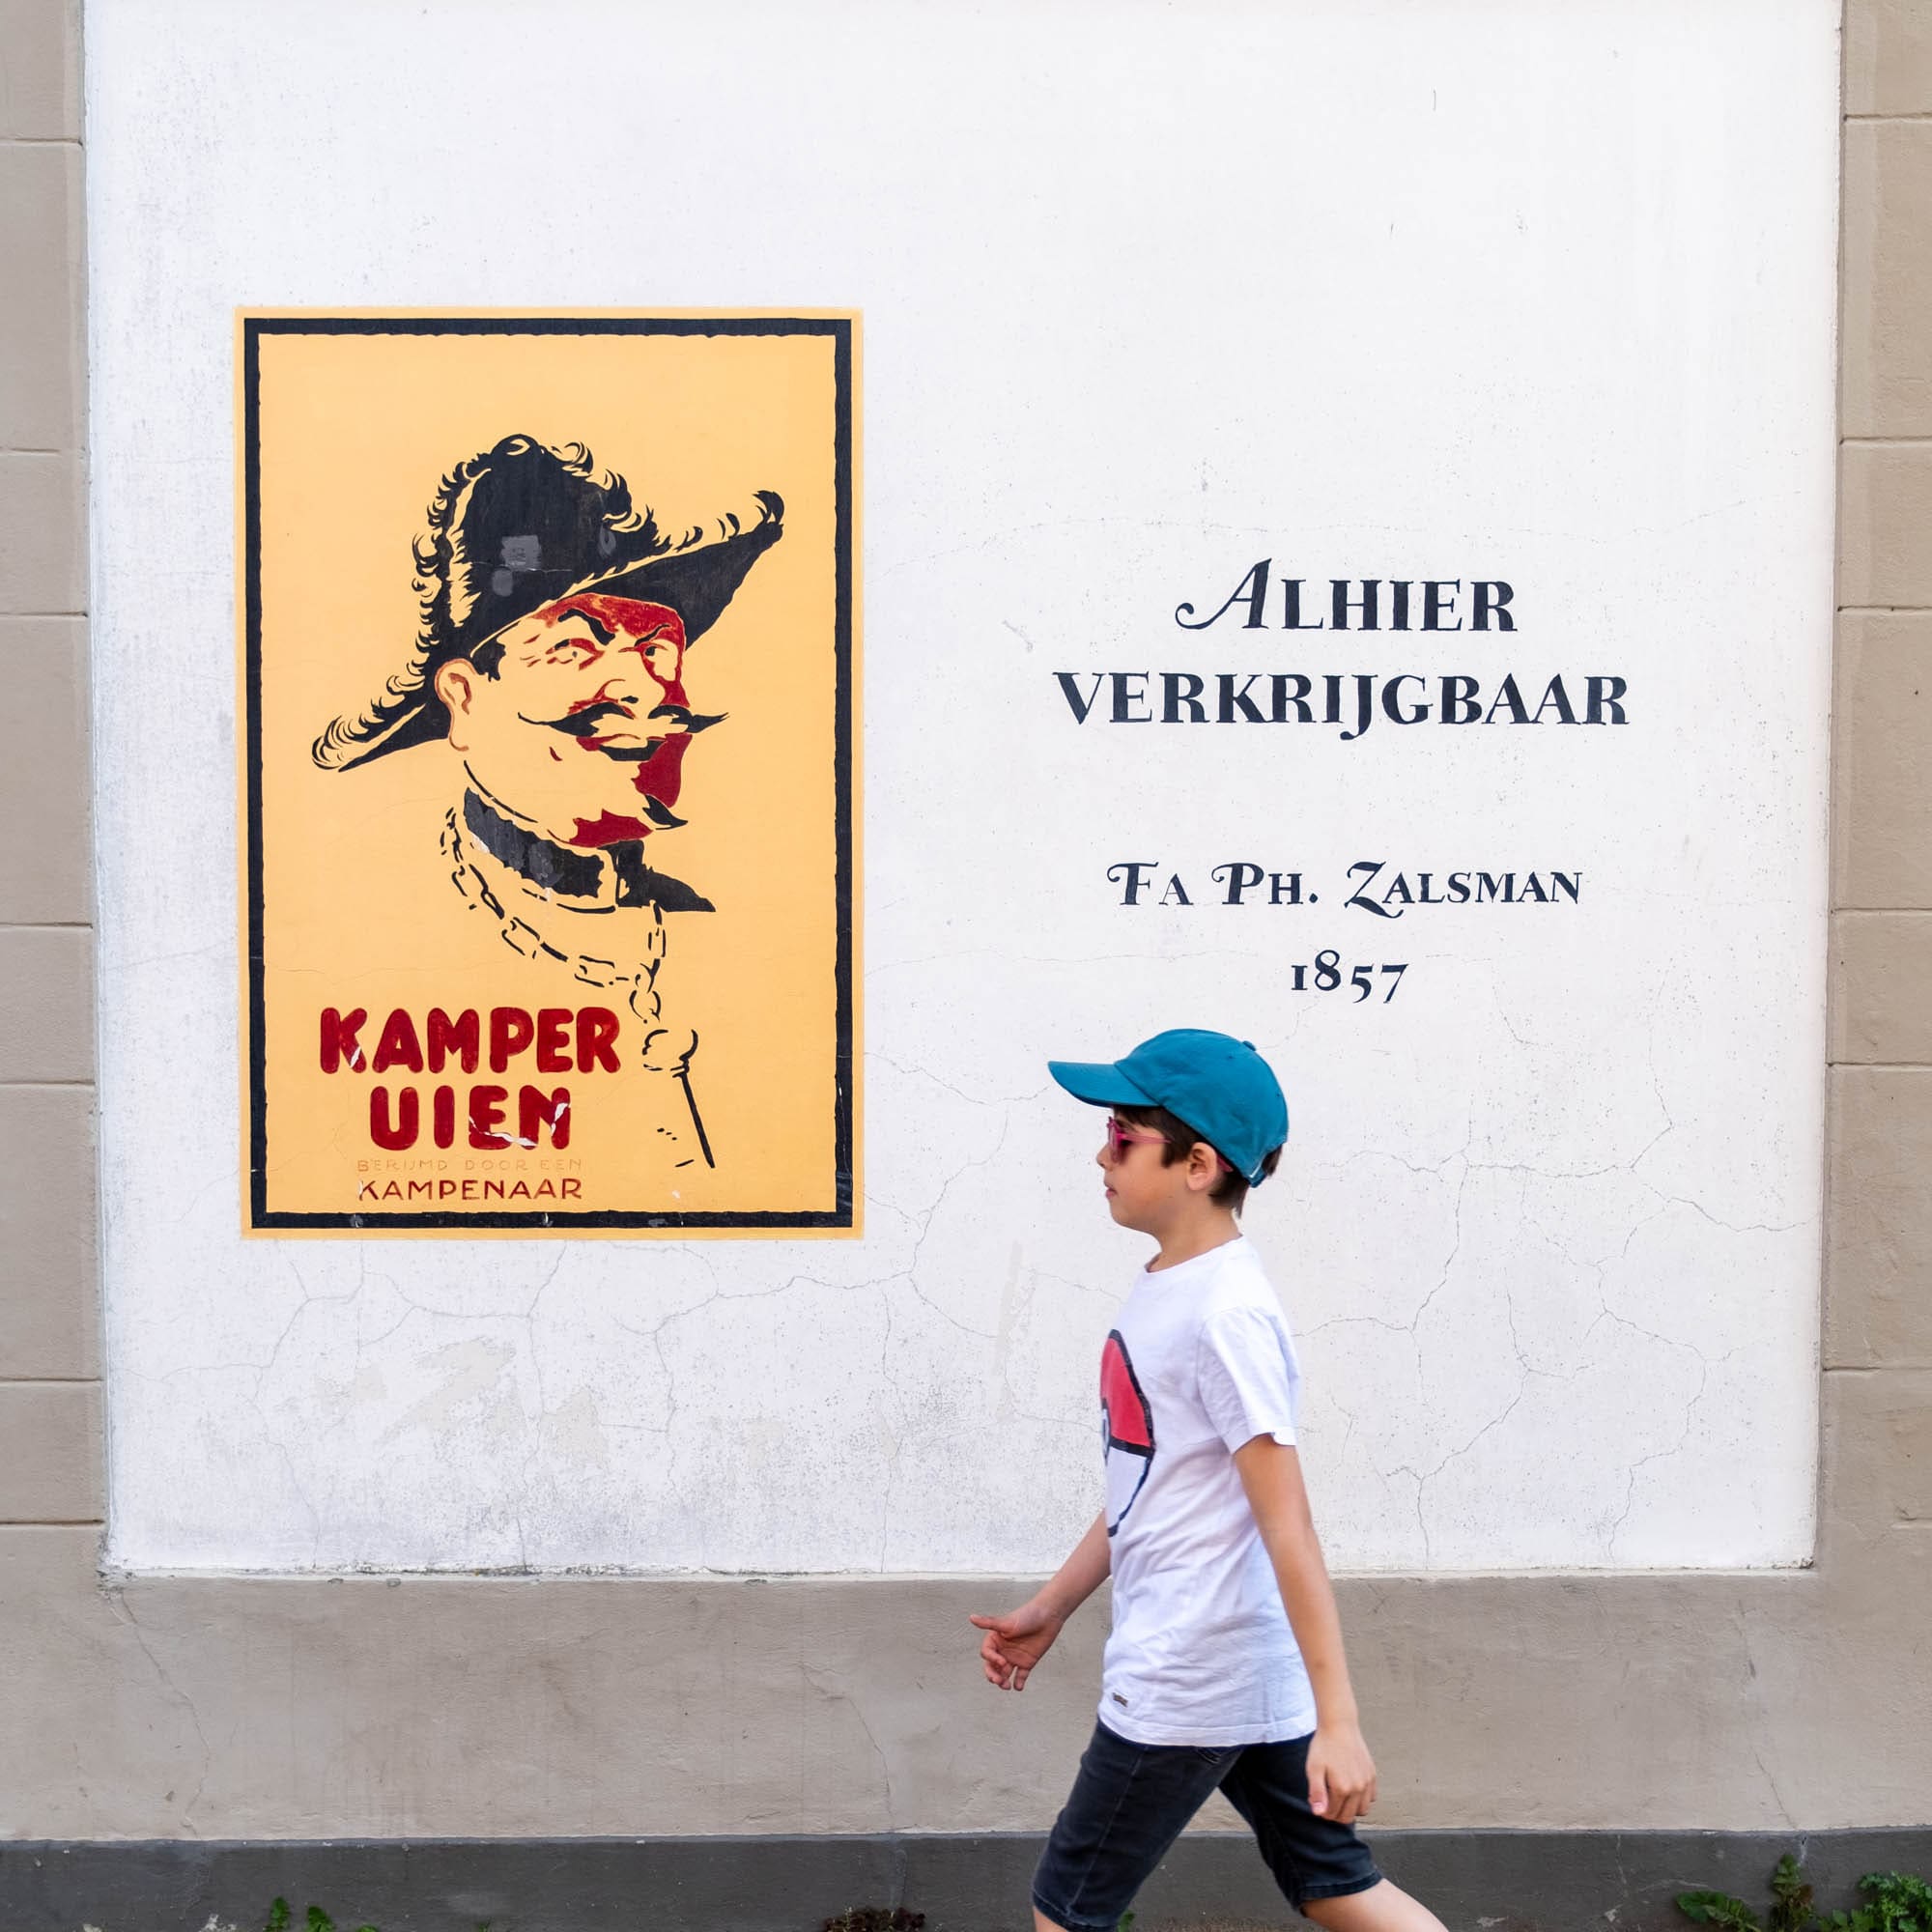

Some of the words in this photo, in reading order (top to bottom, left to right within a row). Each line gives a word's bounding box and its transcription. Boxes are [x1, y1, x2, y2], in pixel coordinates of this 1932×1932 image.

[1175, 557, 1519, 632] ALHIER
[1052, 670, 1630, 741] VERKRIJGBAAR
[1106, 862, 1194, 906] FA
[1210, 862, 1319, 906] PH.
[1344, 861, 1583, 919] ZALSMAN
[1291, 949, 1409, 1004] 1857
[320, 1007, 621, 1074] KAMPER
[369, 1084, 572, 1151] UIEN
[358, 1178, 582, 1201] KAMPENAAR
[465, 1159, 528, 1171] DOOR
[540, 1159, 582, 1171] EEN
